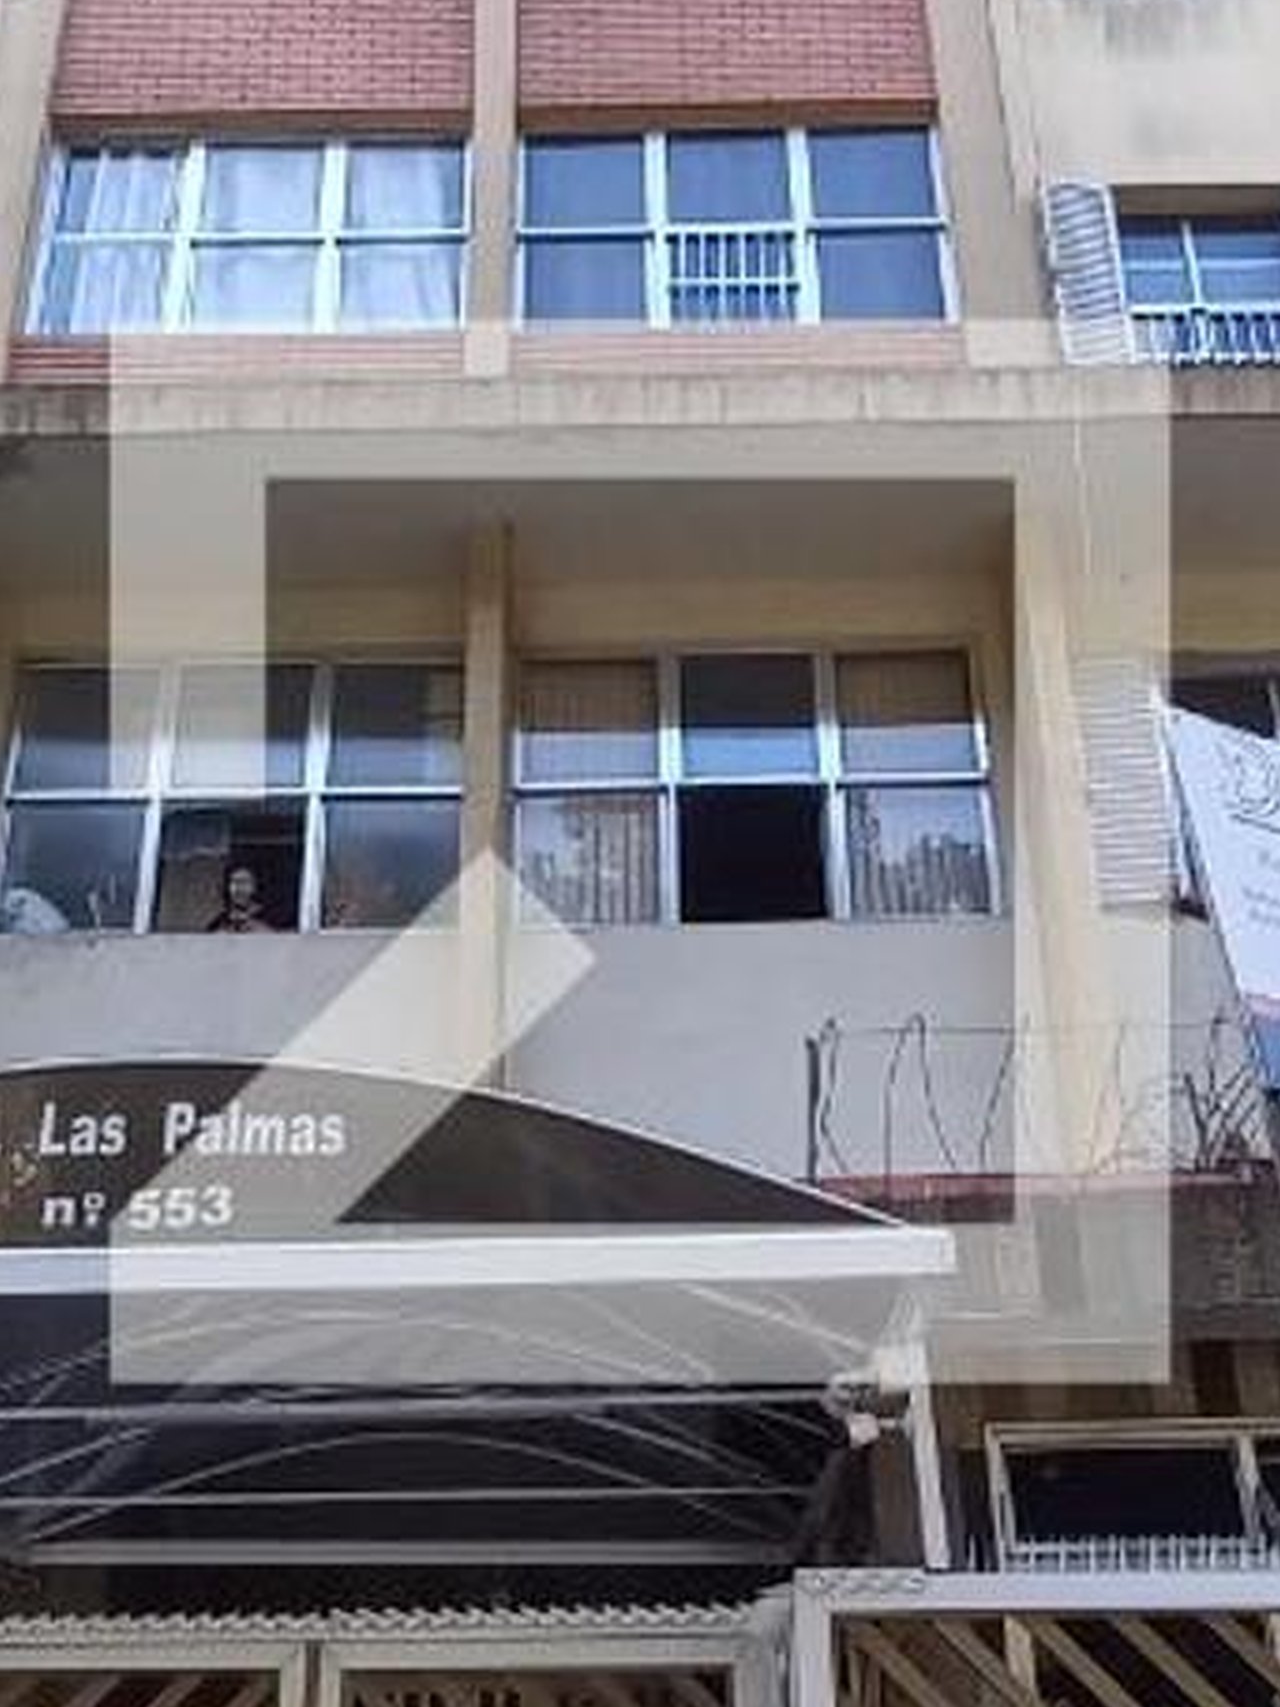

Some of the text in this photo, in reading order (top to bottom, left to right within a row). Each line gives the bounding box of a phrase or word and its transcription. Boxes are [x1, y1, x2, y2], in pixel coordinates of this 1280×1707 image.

[39, 1101, 127, 1156] Las
[163, 1098, 346, 1156] Palmas
[127, 1184, 235, 1231] 553
